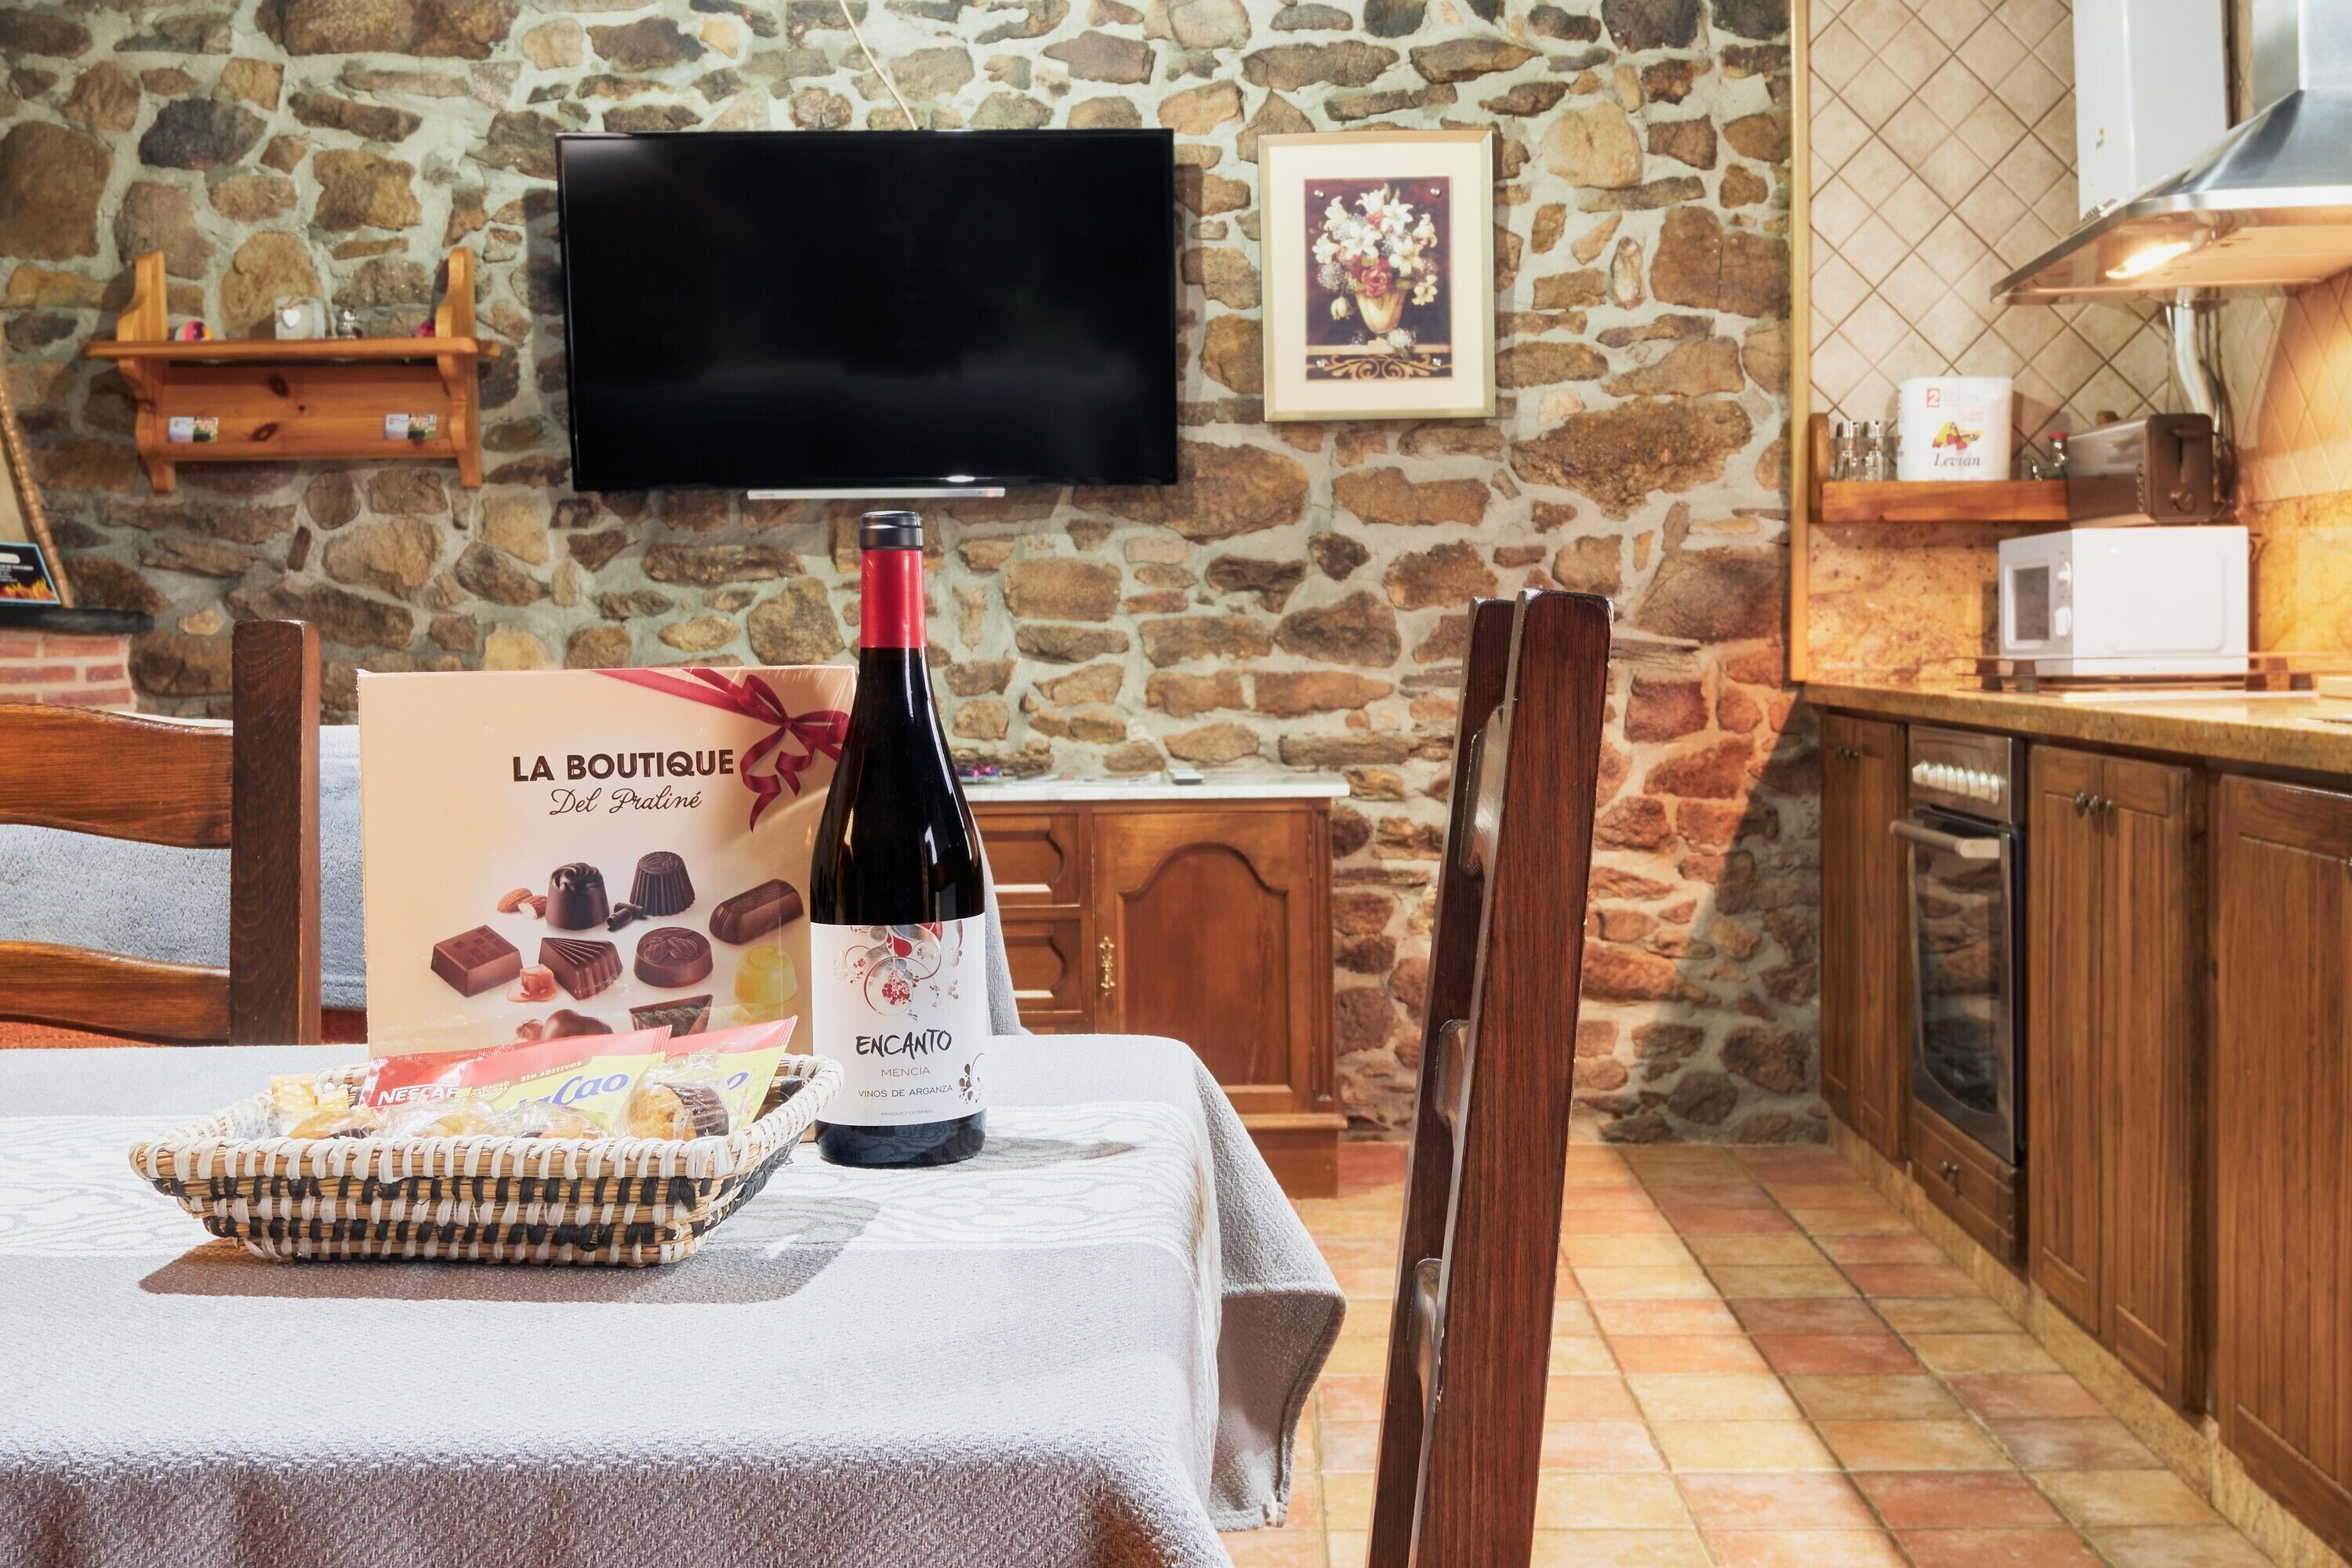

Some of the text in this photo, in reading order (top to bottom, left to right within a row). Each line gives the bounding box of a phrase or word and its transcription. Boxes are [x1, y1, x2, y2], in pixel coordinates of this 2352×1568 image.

[1934, 452, 1980, 466] Levian
[512, 749, 734, 782] LA BOUTIQUE
[549, 785, 702, 815] Del Praliné
[855, 1029, 952, 1060] ENCANTO
[521, 1061, 583, 1082] SIN ADITIVOS
[880, 1065, 931, 1077] MENCÍA
[482, 1080, 510, 1091] CACAO
[858, 1089, 887, 1098] VINOS
[909, 1084, 953, 1096] ARGANZA
